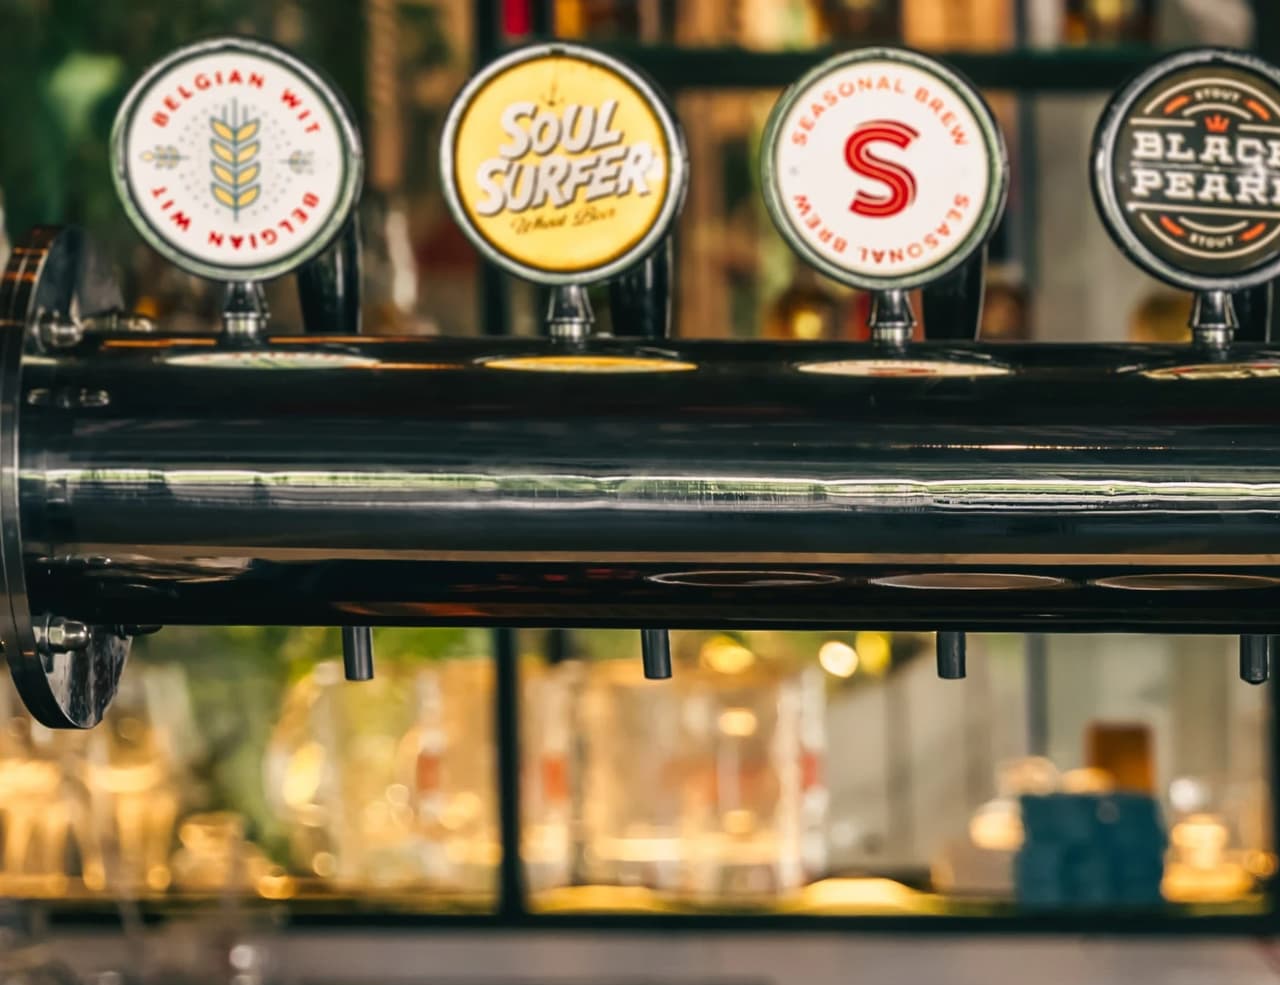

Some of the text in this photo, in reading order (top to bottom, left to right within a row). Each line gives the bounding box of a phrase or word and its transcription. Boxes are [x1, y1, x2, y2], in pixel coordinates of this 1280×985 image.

[152, 69, 321, 133] BELGIAN WIT
[792, 75, 968, 146] SEASONAL BREW
[1194, 88, 1241, 102] STOUT
[498, 100, 624, 160] SOUL
[475, 140, 654, 218] SURFER
[843, 118, 921, 219] S
[152, 186, 319, 249] BELGIAN WIT
[794, 193, 970, 264] SEASONAL BREW
[1189, 233, 1235, 247] STOUT
